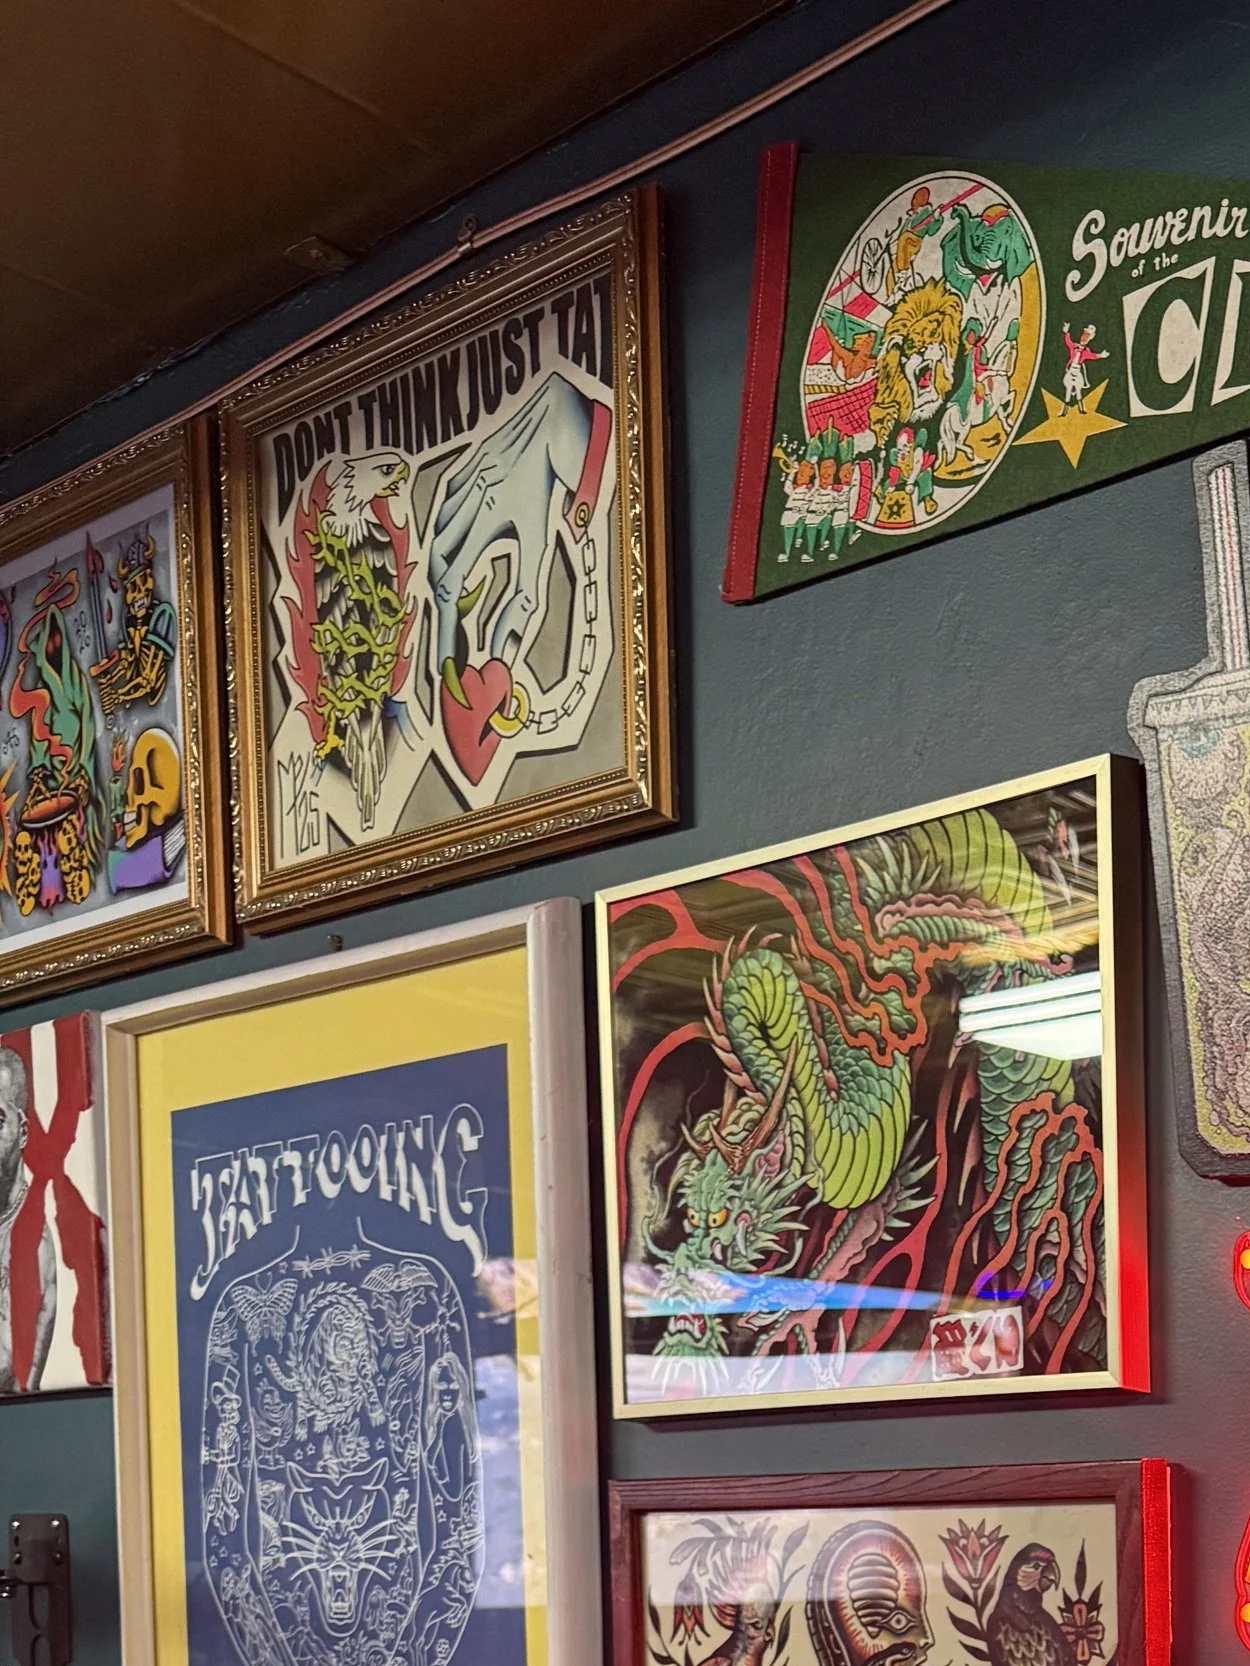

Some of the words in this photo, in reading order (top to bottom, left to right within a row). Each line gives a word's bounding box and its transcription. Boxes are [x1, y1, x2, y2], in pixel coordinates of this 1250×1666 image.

[1065, 199, 1250, 302] Souvenir
[1131, 263, 1147, 279] of
[1153, 252, 1179, 272] the
[273, 402, 353, 527] DONT
[358, 346, 470, 456] THINK
[464, 306, 546, 433] JUST
[190, 1103, 488, 1300] TATTOOING
